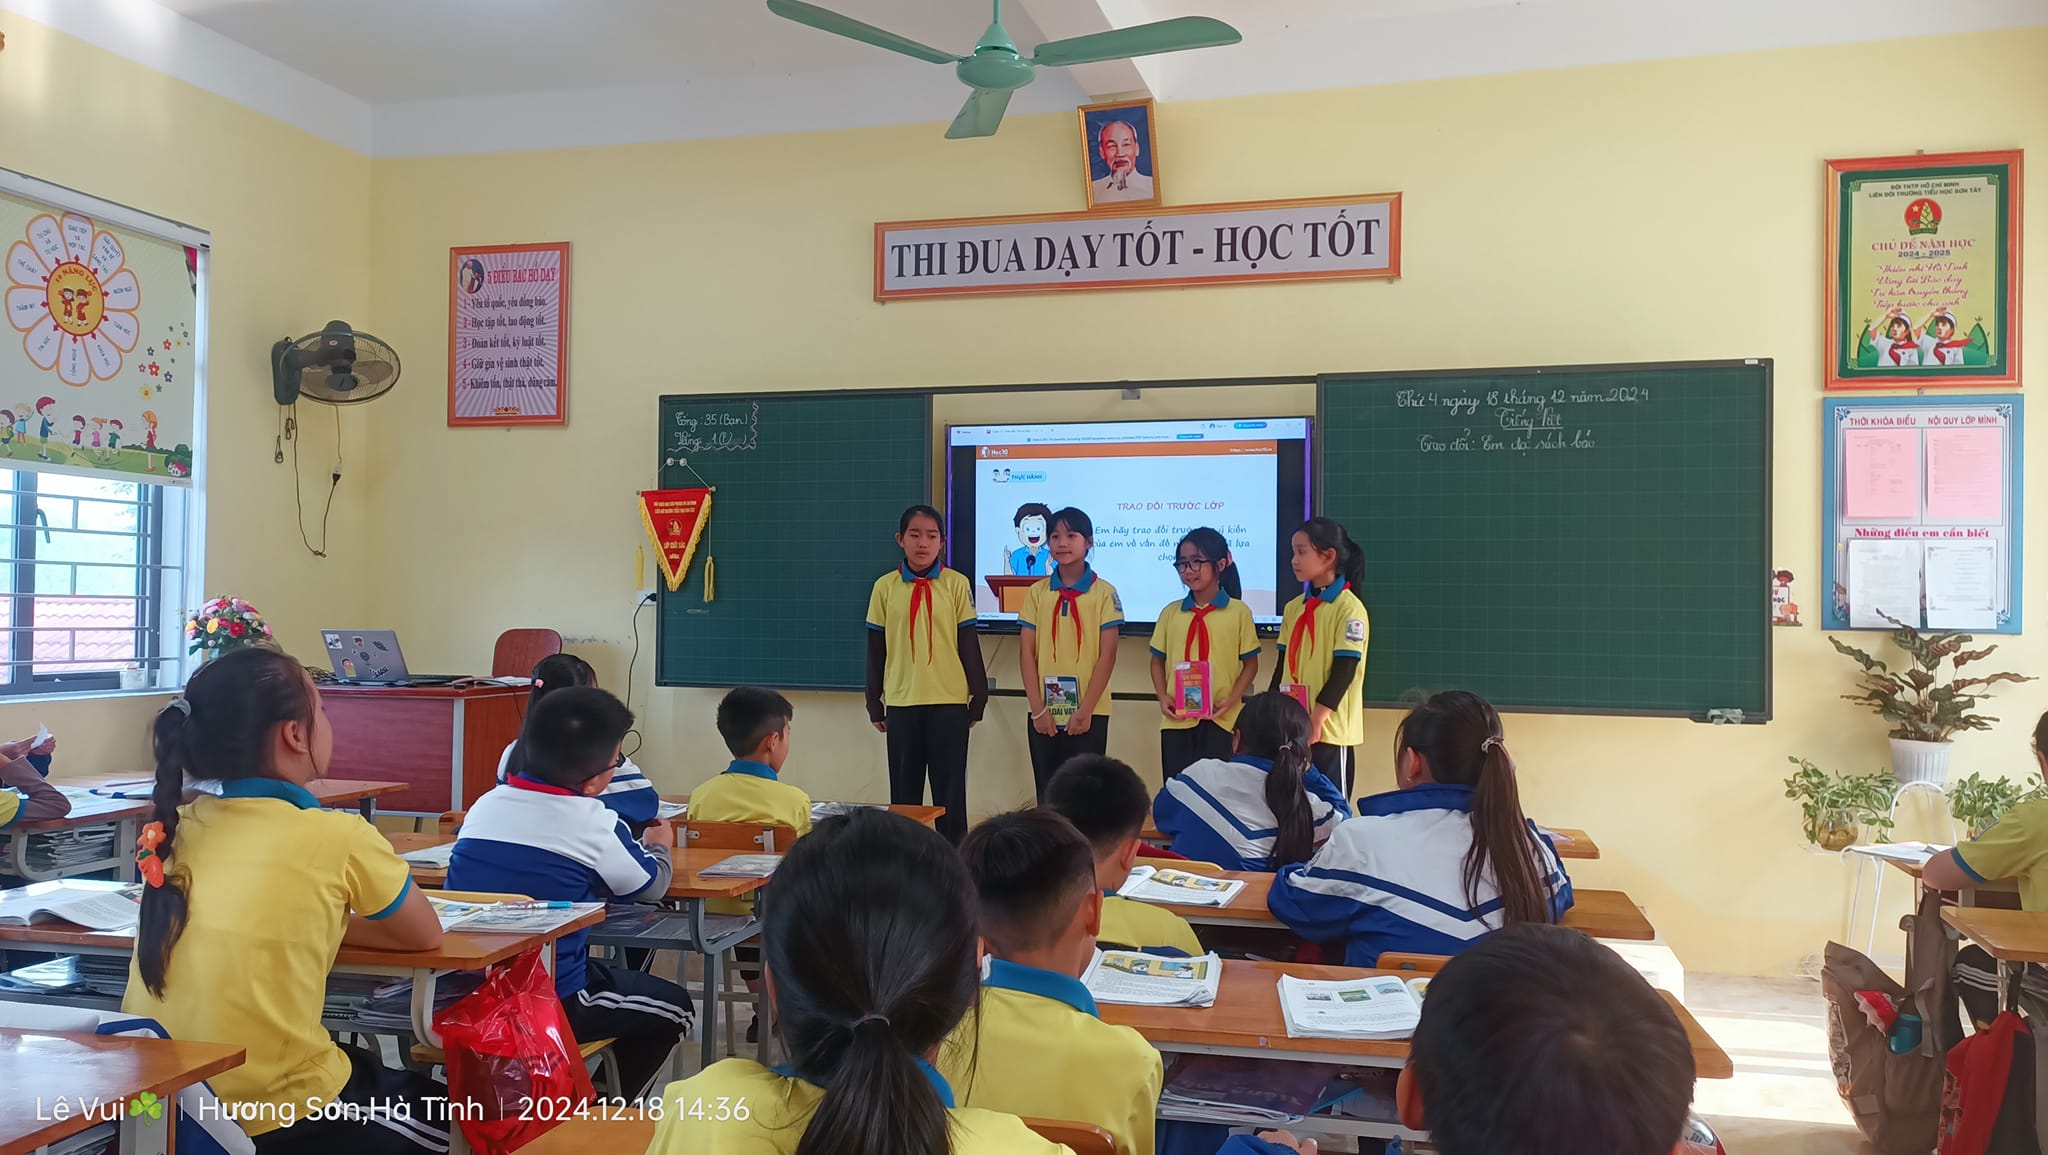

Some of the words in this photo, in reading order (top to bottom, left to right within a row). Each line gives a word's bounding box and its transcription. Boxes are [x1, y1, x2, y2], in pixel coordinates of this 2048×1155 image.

[891, 242, 948, 277] THI
[956, 237, 1025, 275] ĐUA
[1034, 233, 1104, 277] DẠY
[1113, 220, 1184, 267] TỐT
[1193, 247, 1204, 255] -
[1213, 224, 1293, 269] HỌC
[1304, 209, 1380, 258] TỐT
[1871, 238, 1896, 251] CHỦ
[1920, 239, 1945, 249] NĂM
[1950, 239, 1975, 249] HỌC
[1929, 249, 1951, 257] 2025
[487, 271, 492, 284] 5
[513, 265, 527, 283] BÁC
[541, 268, 556, 285] DẠY
[471, 317, 484, 331] Học
[508, 315, 518, 327] lao
[505, 357, 518, 368] sinh
[1396, 389, 1425, 407] Thứ
[1429, 392, 1438, 406] 4
[1442, 389, 1480, 416] ngày
[1486, 391, 1499, 406] 18
[1504, 388, 1546, 411] tháng
[1551, 389, 1565, 404] 12
[1570, 390, 1604, 403] năm
[1606, 386, 1649, 403] 2024
[704, 413, 718, 426] 35
[1850, 416, 1869, 426] THỜI
[1871, 416, 1894, 425] KHÓA
[1896, 413, 1916, 425] BIỂU
[1928, 416, 1941, 426] NỘI
[1943, 416, 1958, 425] QUY
[1961, 415, 1976, 424] LỚP
[1978, 414, 1997, 424] MÌNH
[1481, 434, 1505, 451] Em
[1536, 431, 1566, 449] sách
[1117, 502, 1143, 510] TRAO
[1147, 501, 1163, 510] ĐỔI
[1168, 500, 1201, 510] TRƯỚC
[1205, 501, 1225, 510] LỚP
[1113, 525, 1129, 536] hãy
[1132, 526, 1151, 534] trao
[1154, 524, 1169, 534] đổi
[1855, 527, 1891, 539] Những
[1894, 526, 1918, 537] điều
[1922, 530, 1939, 538] em
[1943, 526, 1963, 538] cần
[1967, 526, 1989, 538] biết
[1235, 539, 1250, 549] lựa
